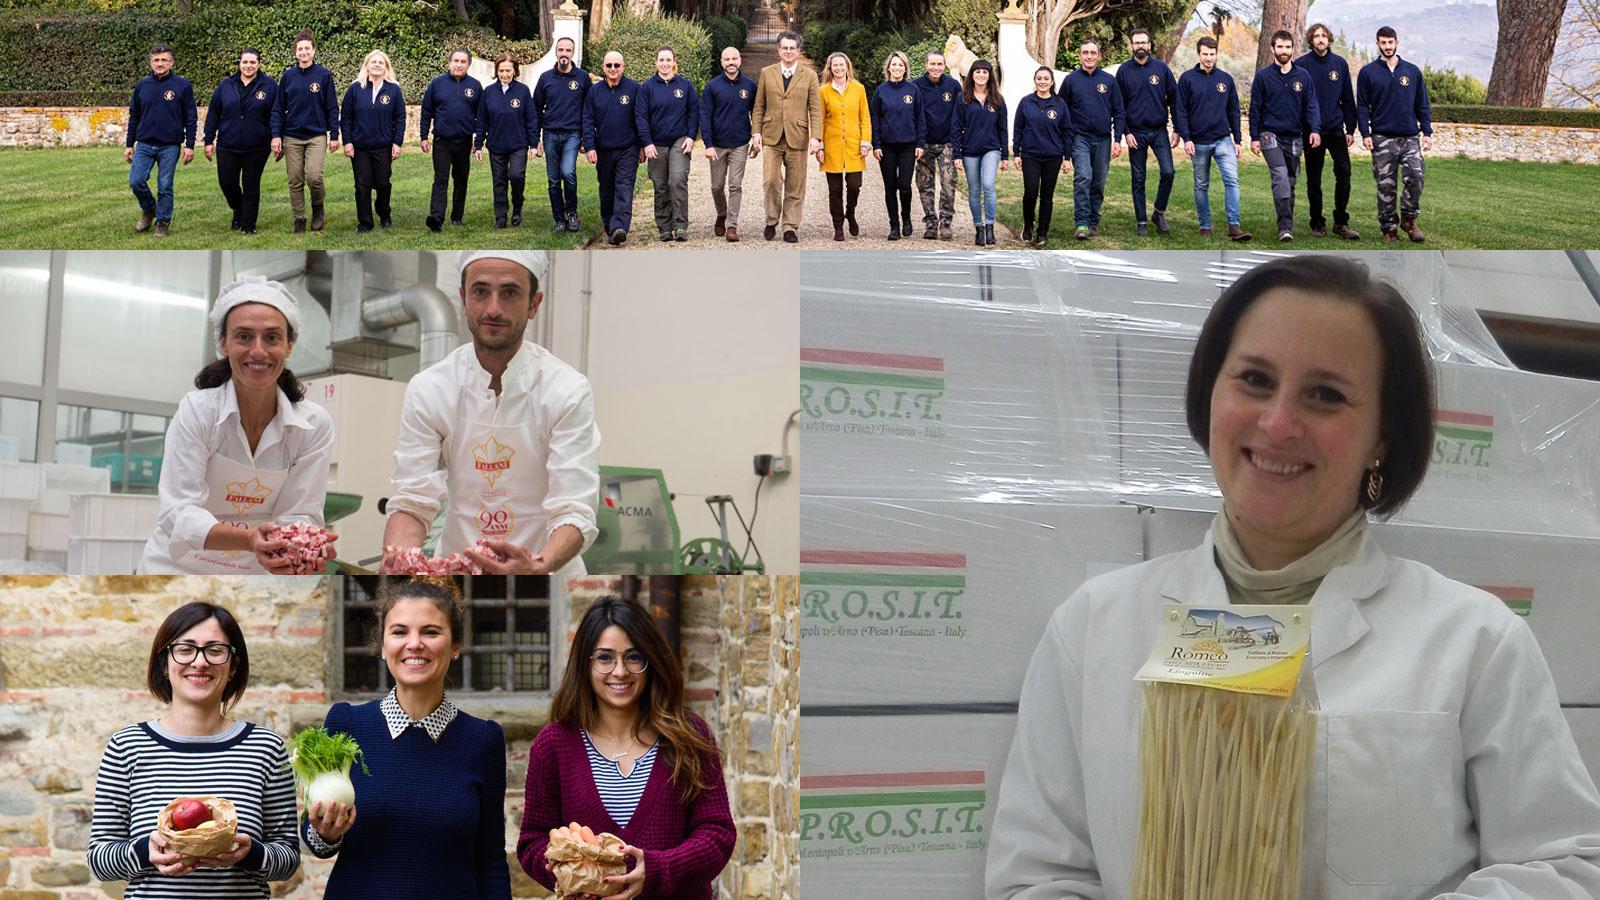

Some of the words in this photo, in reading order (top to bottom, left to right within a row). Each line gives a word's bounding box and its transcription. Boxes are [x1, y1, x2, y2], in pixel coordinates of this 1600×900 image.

[324, 384, 335, 400] 19
[617, 505, 653, 517] ACMA
[480, 510, 507, 529] 90
[800, 625, 819, 639] poli
[945, 625, 966, 639] Italy
[1171, 646, 1229, 661] Romeo
